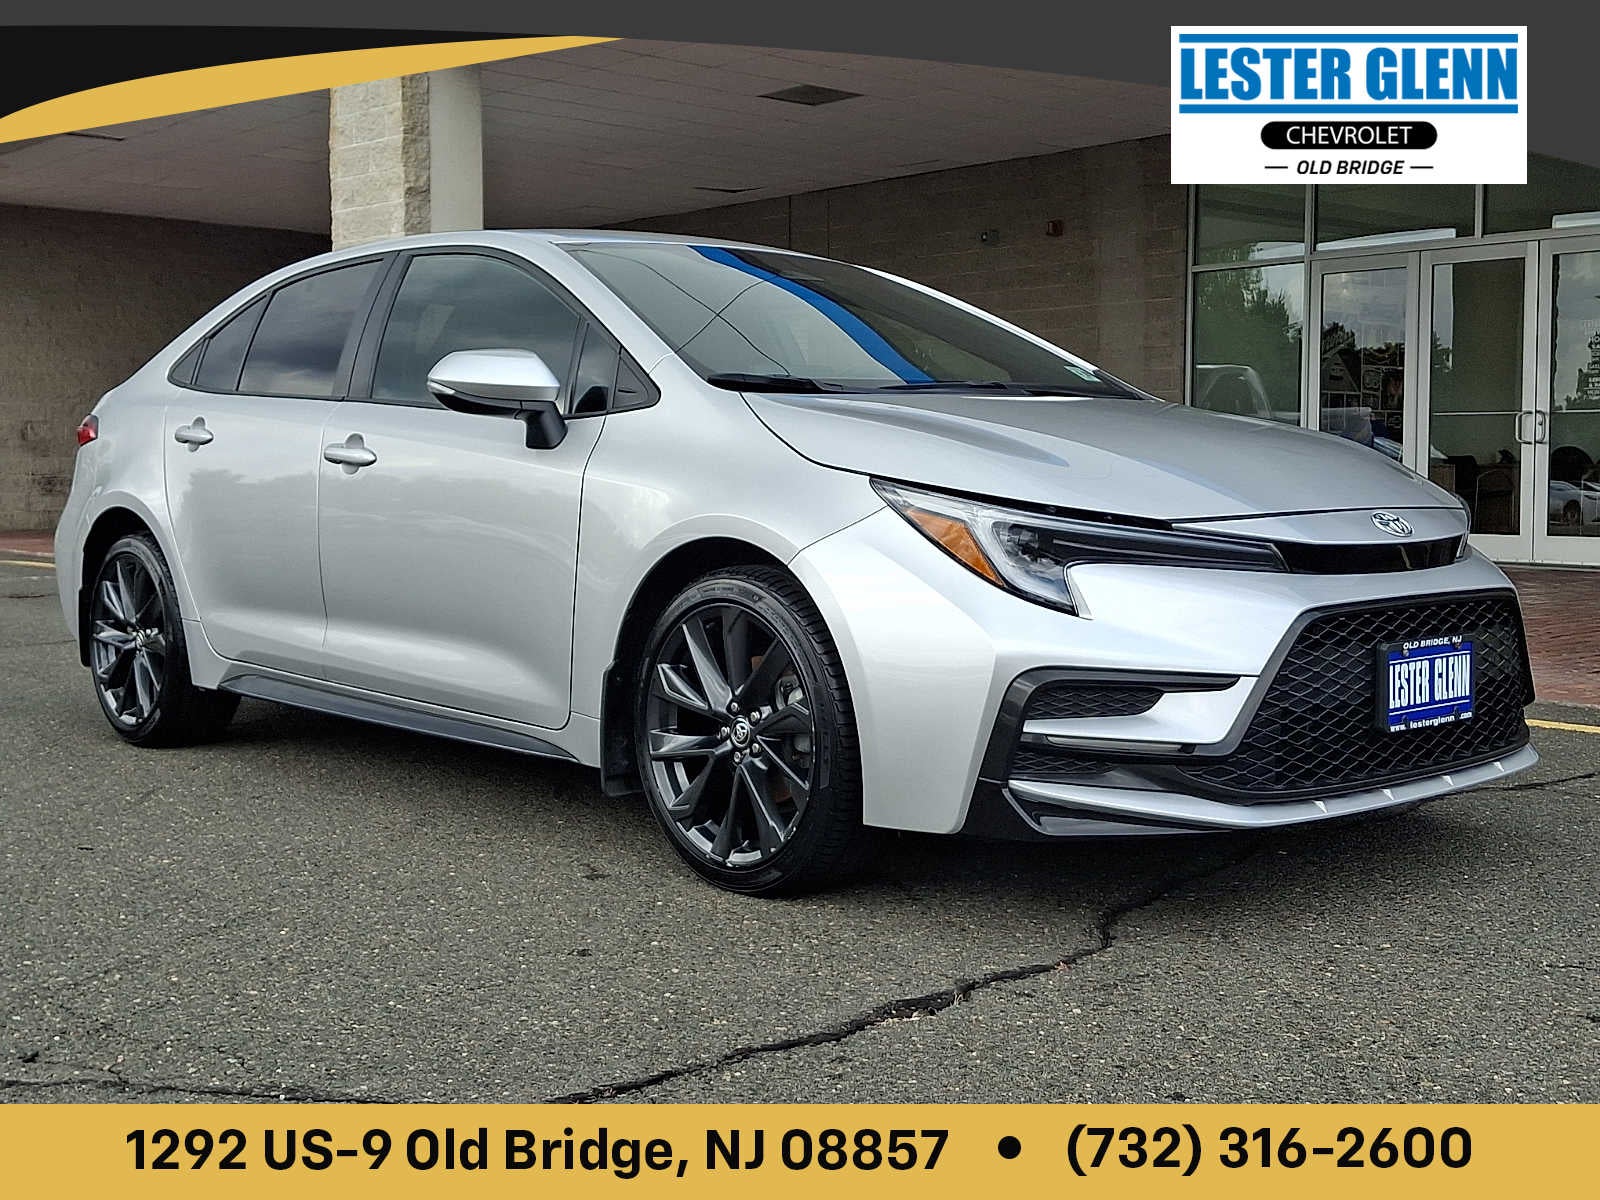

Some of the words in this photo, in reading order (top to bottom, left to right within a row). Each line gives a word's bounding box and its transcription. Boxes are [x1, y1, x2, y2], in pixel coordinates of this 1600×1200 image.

[1403, 642, 1419, 650] OLD
[1452, 635, 1462, 643] NJ
[1389, 660, 1430, 709] LESTER
[1434, 654, 1471, 701] GLENN
[1410, 715, 1455, 729] lesterglenn
